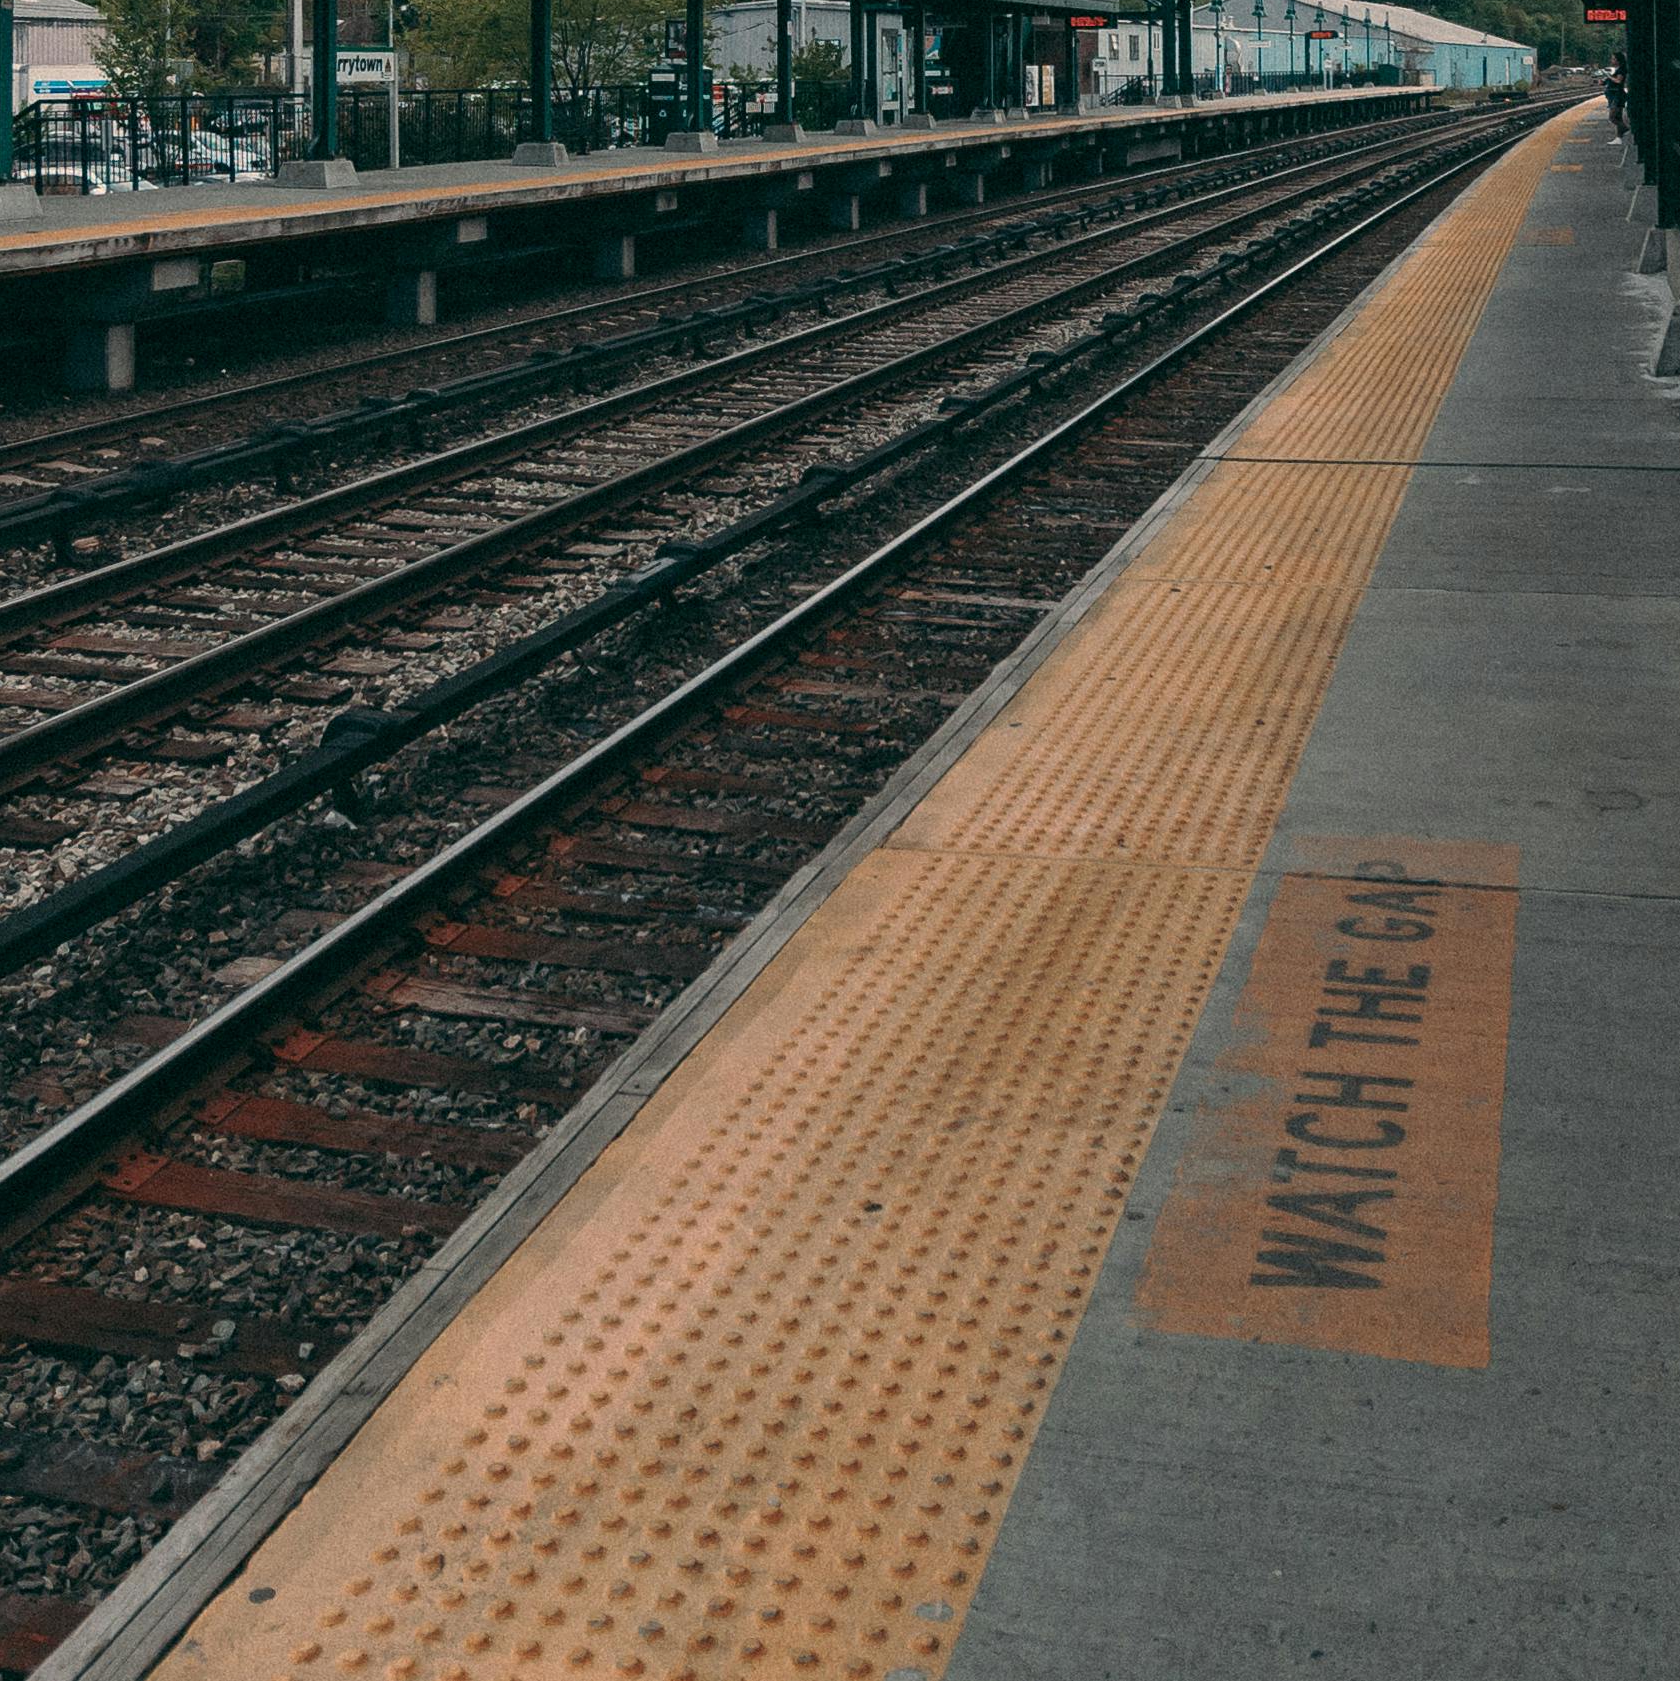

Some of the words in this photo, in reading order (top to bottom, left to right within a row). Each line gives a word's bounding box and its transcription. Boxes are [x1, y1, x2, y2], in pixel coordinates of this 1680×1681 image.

[1336, 858, 1442, 942] GAP
[1308, 959, 1433, 1048] THE
[1250, 1071, 1414, 1290] WATCH
